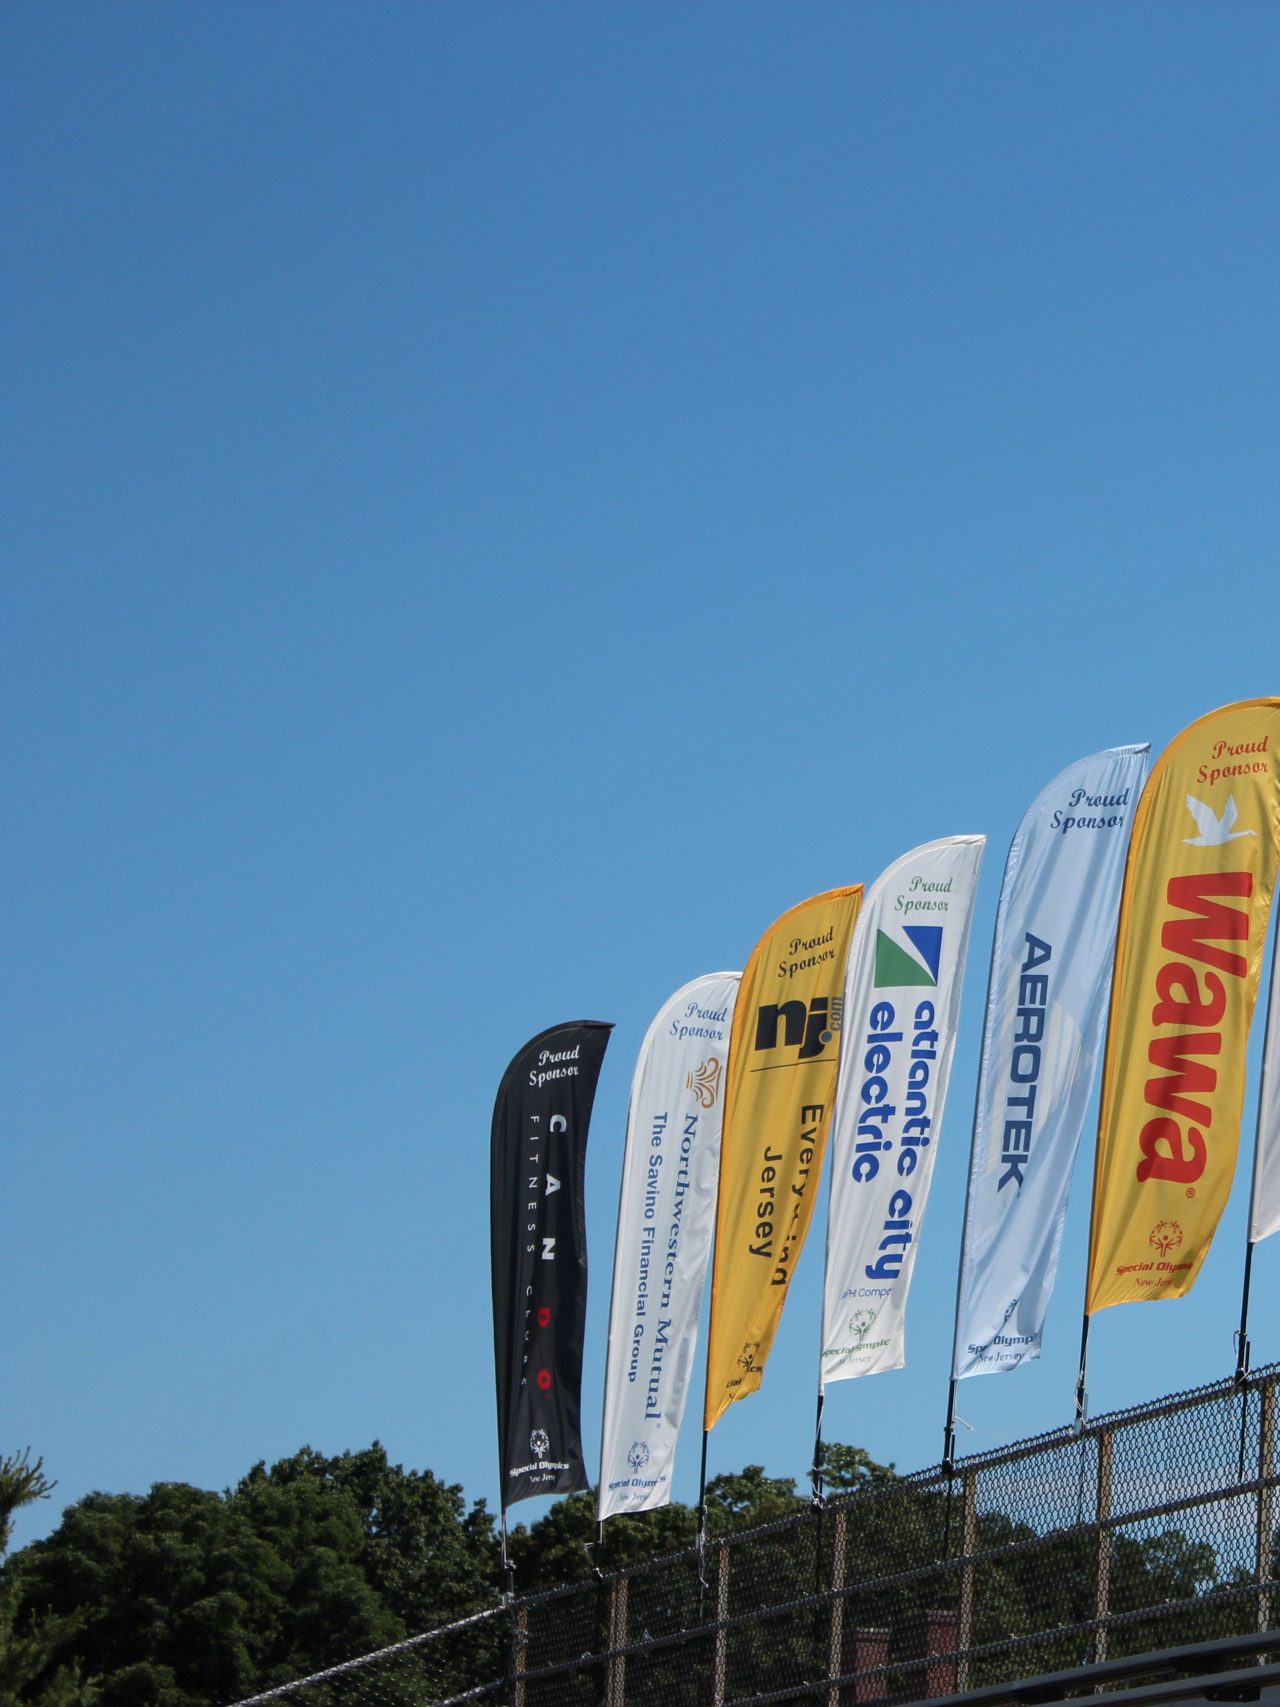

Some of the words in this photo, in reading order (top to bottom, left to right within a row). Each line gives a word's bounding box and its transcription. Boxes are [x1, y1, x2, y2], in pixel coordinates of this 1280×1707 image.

[1211, 735, 1268, 760] Proud
[1197, 762, 1268, 786] Sponsor
[1068, 788, 1130, 808] Proud
[909, 876, 953, 893] Proud
[894, 895, 949, 915] Sponsor
[789, 926, 834, 955] Proud
[778, 949, 836, 978] Sponsor
[685, 1002, 728, 1023] Proud
[1136, 871, 1253, 1184] Wawa
[669, 1020, 725, 1040] Sponsor
[538, 1044, 580, 1066] Proud
[997, 931, 1053, 1199] AEROTEK
[529, 1066, 579, 1088] Sponsor
[852, 1001, 903, 1183] electric
[897, 1000, 939, 1177] atlantic
[651, 1112, 668, 1147] The
[527, 1115, 540, 1252] FITNESS
[644, 1154, 663, 1220] Savino
[660, 1113, 698, 1310] Northwestern
[749, 1146, 783, 1258] Jersey
[865, 1189, 913, 1280] city
[636, 1227, 656, 1317] Financial
[1115, 1262, 1154, 1276] Special
[628, 1324, 645, 1383] Group
[645, 1319, 672, 1421] Mutual
[509, 1462, 537, 1477] Special
